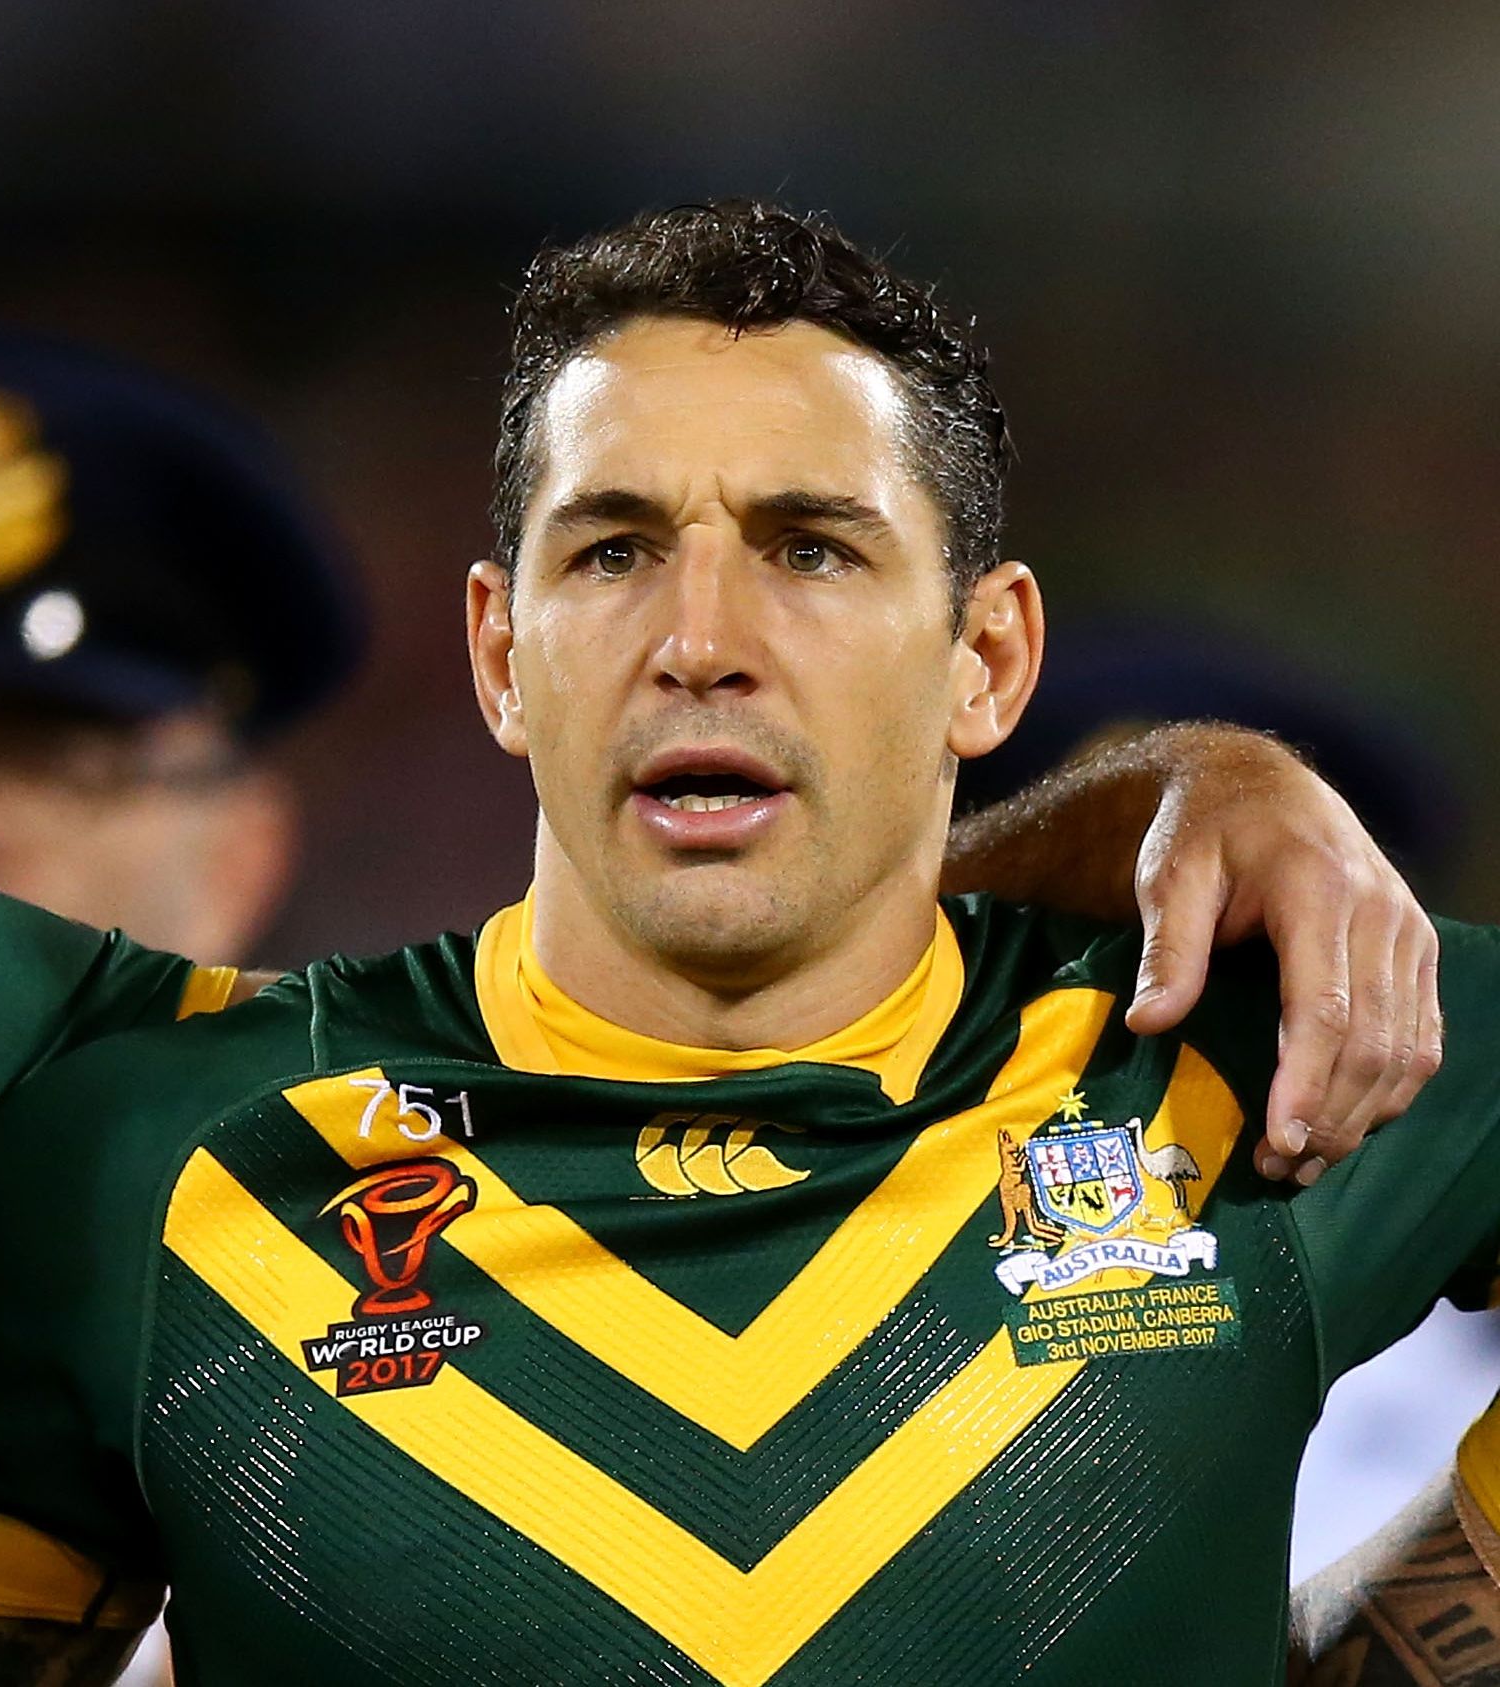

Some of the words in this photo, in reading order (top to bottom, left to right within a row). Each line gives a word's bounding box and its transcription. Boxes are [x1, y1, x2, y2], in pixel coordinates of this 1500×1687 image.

[348, 1078, 475, 1142] 751
[1043, 1244, 1182, 1286] AUSTRALIA
[1028, 1292, 1133, 1322] AUSTRALIA
[1135, 1294, 1146, 1308] v
[1150, 1284, 1219, 1308] FRANCE
[335, 1323, 388, 1341] RUGBY
[392, 1316, 455, 1333] LEAGUE
[1017, 1324, 1054, 1344] GIO
[1058, 1312, 1140, 1337] STADIUM,
[1143, 1304, 1234, 1326] CANBERRA
[1047, 1341, 1078, 1360] 3rd
[1081, 1331, 1179, 1356] NOVEMBER
[1183, 1327, 1216, 1345] 2017
[311, 1333, 415, 1365] WORLD
[422, 1325, 482, 1349] CUP
[345, 1351, 441, 1389] 2017
